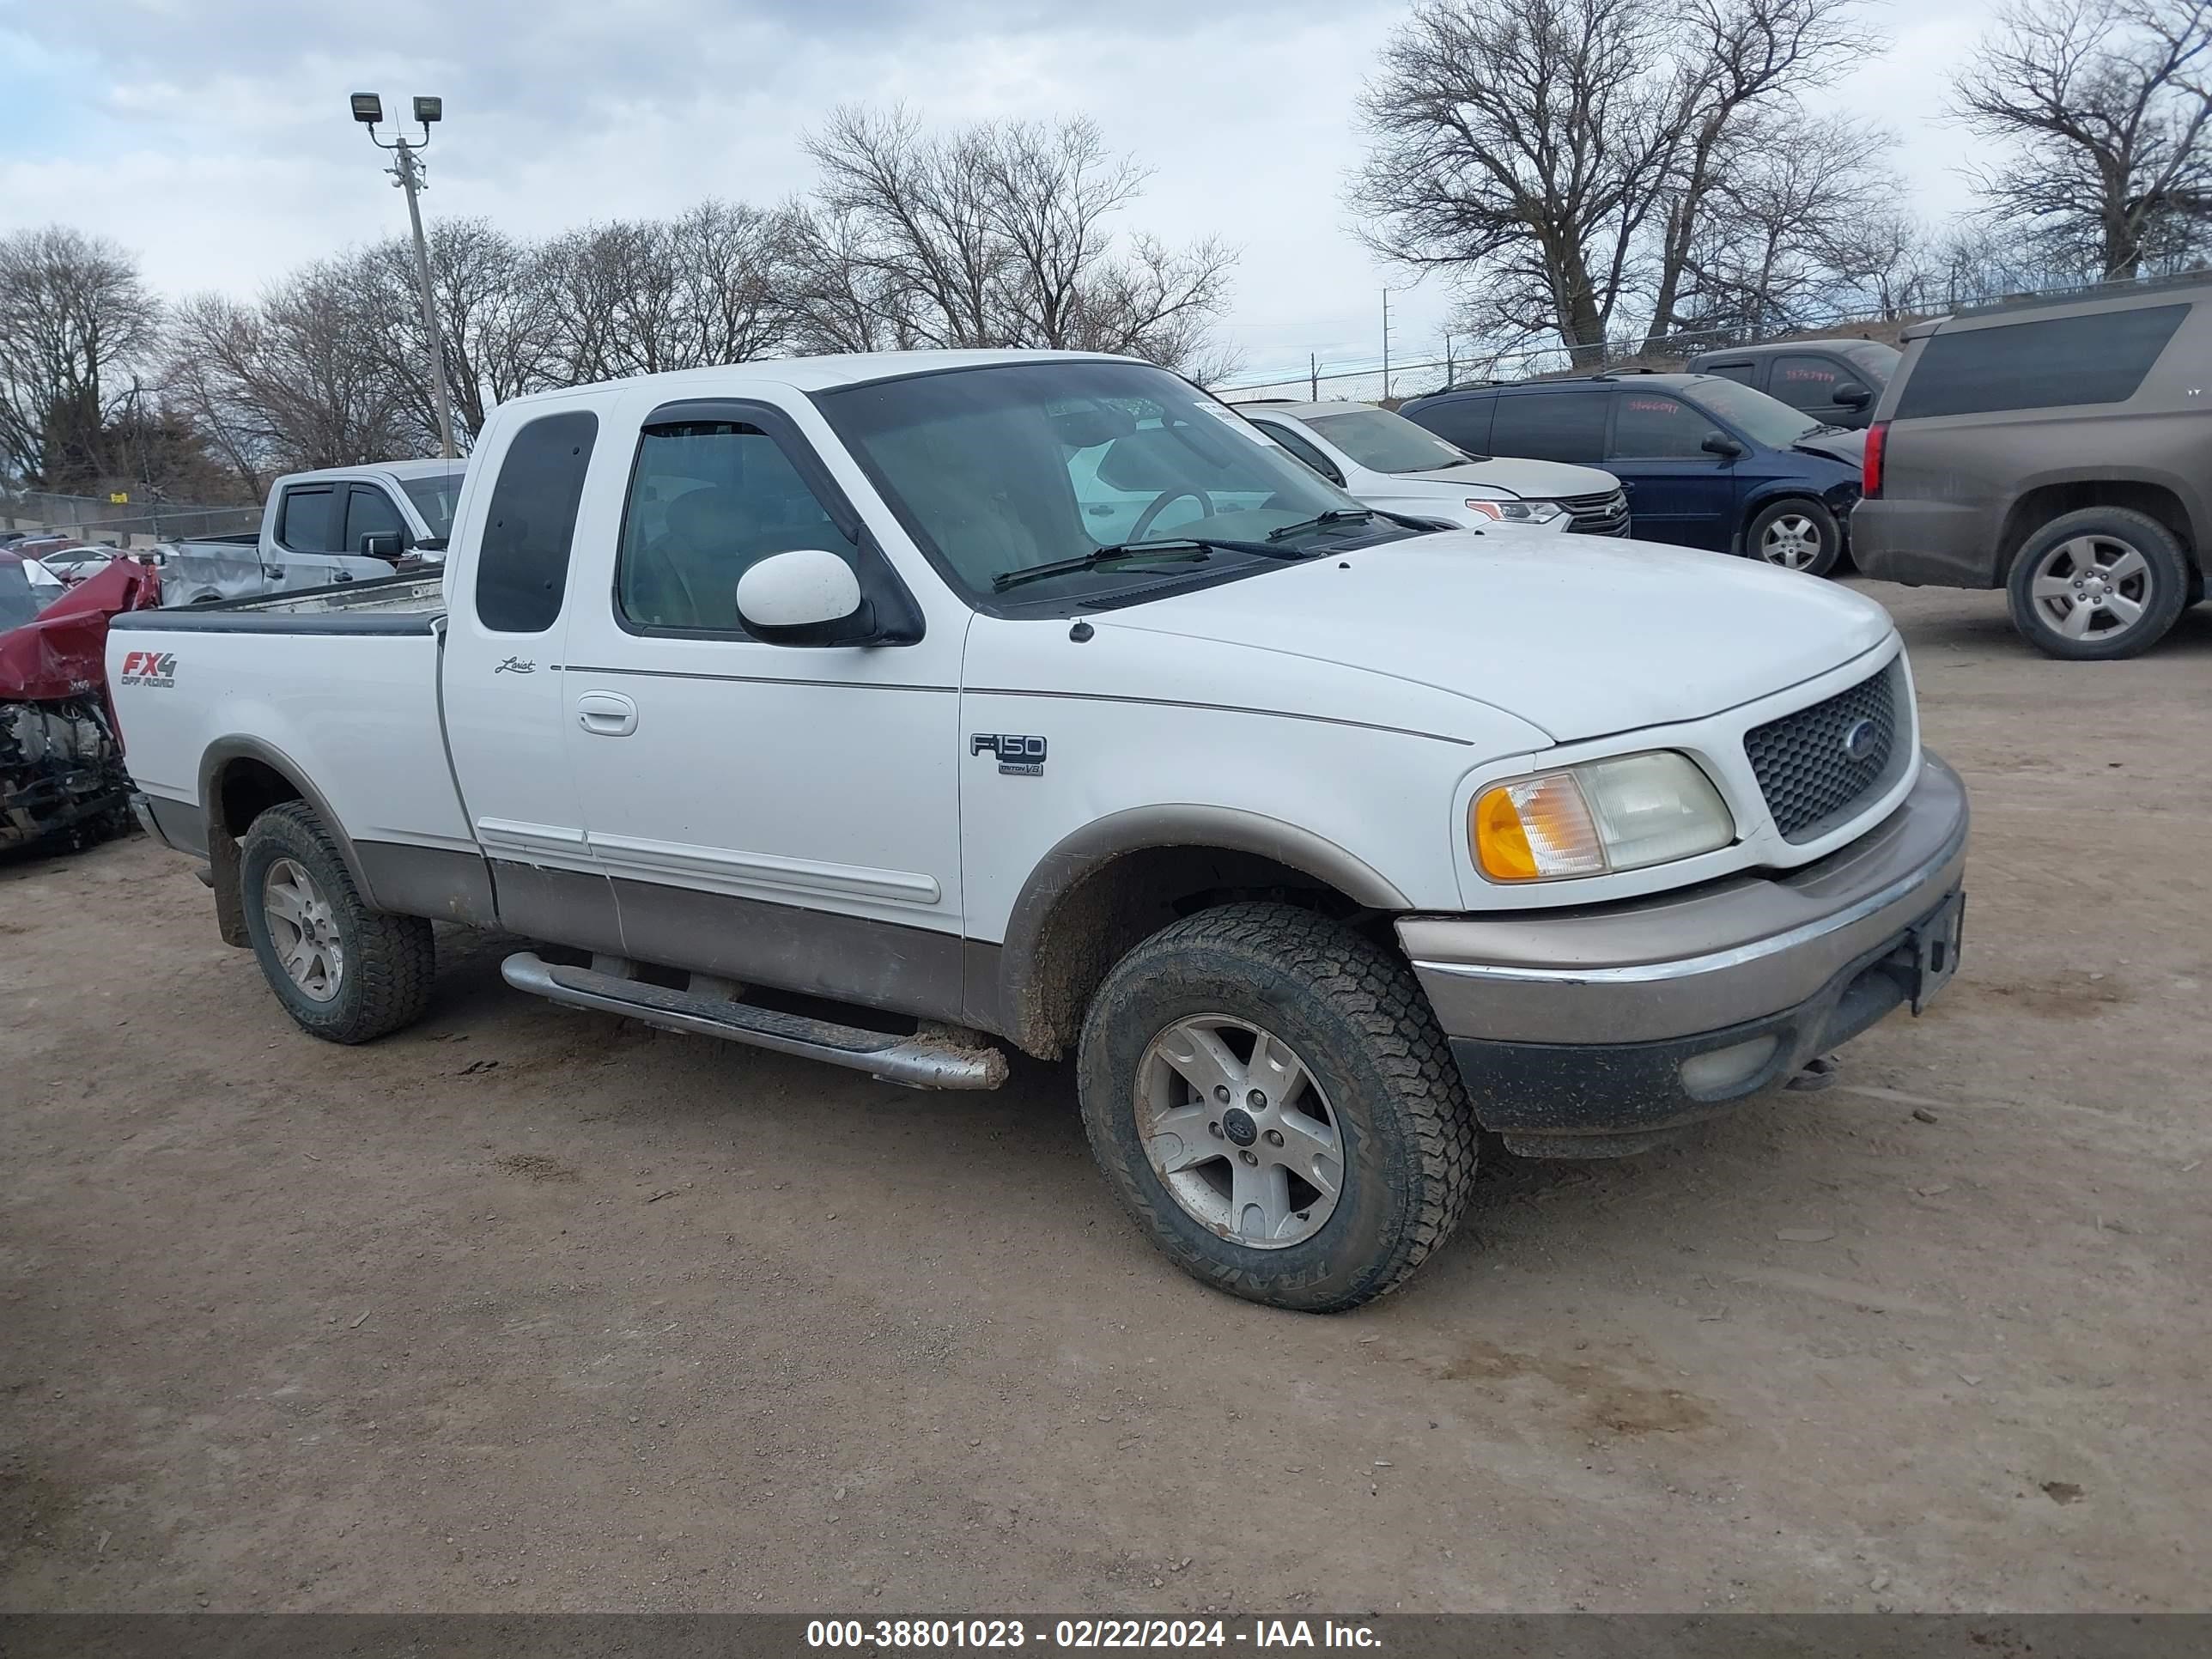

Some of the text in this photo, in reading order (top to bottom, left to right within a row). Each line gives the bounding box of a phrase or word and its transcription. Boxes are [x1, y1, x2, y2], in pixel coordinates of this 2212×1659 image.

[122, 651, 178, 677] FX4
[495, 655, 536, 674] Lariat
[121, 677, 175, 688] OFF ROAD
[970, 733, 1045, 757] F-150
[1026, 764, 1040, 773] V8
